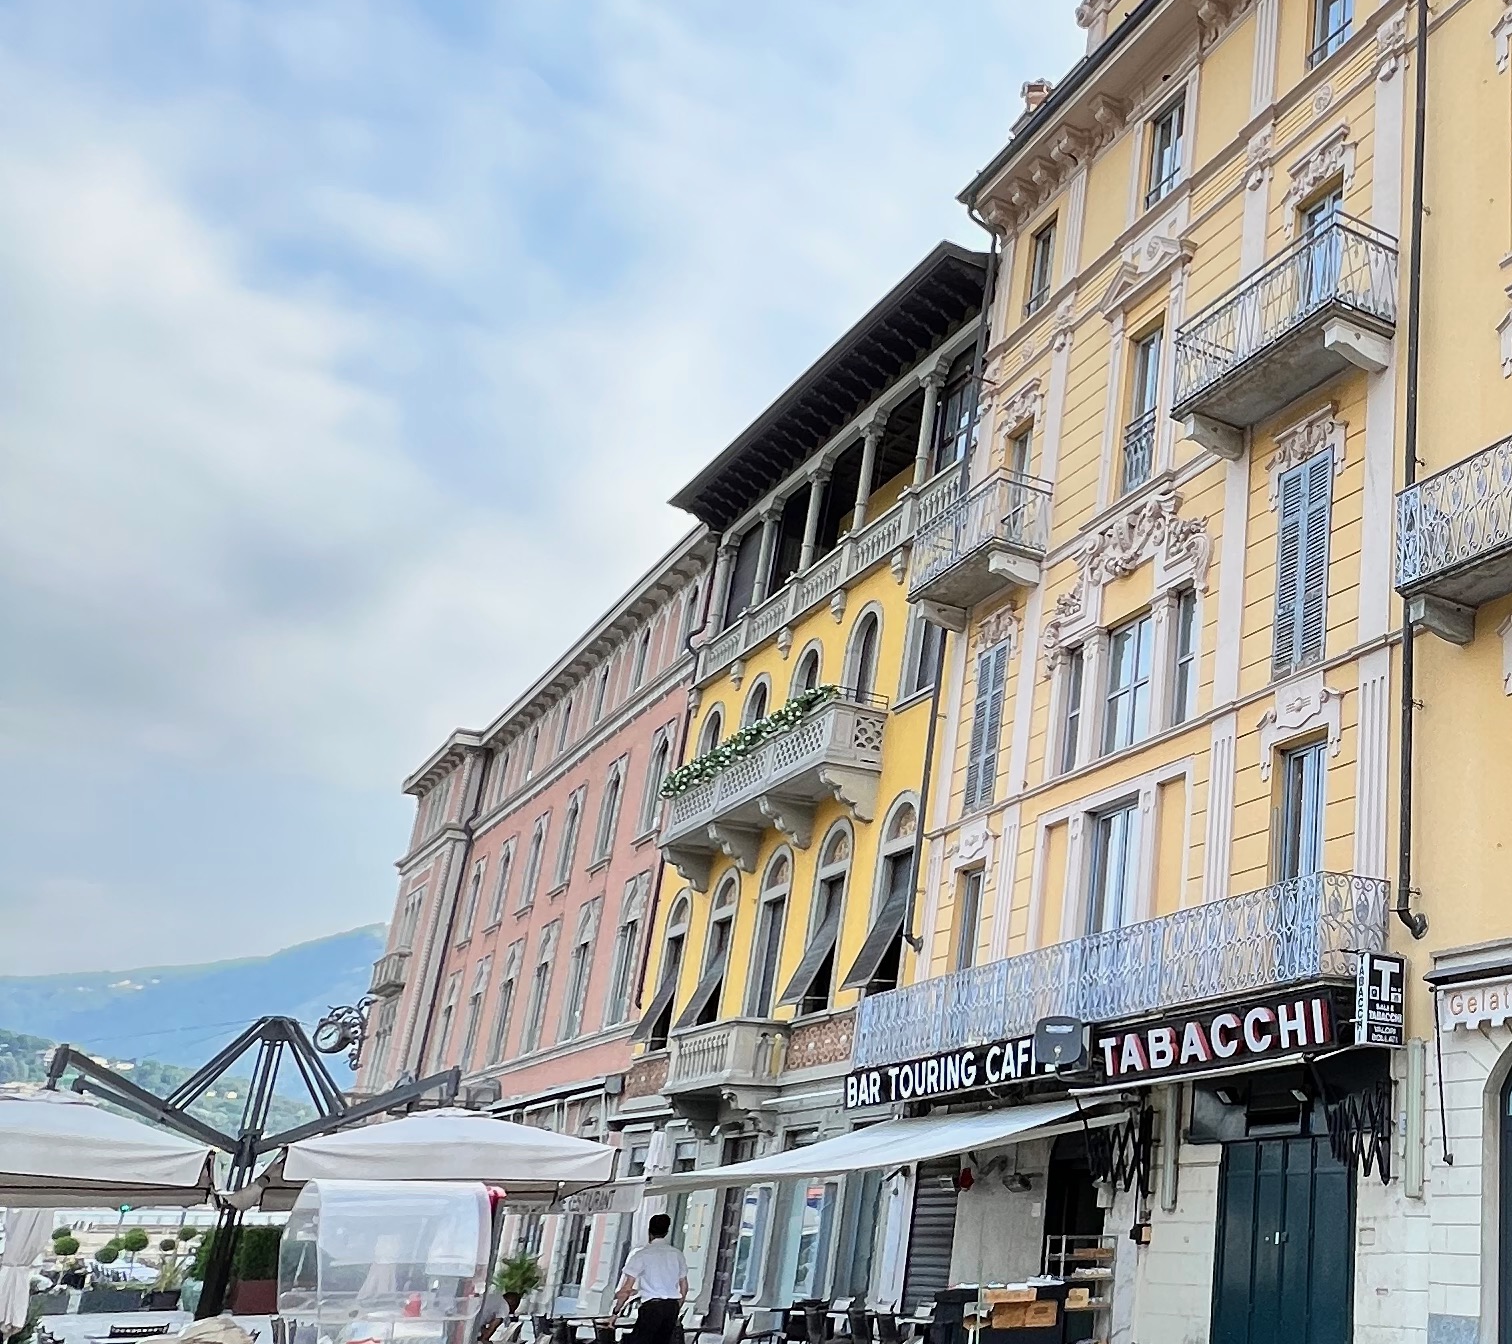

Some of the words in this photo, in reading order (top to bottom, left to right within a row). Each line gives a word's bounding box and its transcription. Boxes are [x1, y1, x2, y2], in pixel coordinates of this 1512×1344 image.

[1373, 959, 1400, 1002] T
[1099, 998, 1332, 1077] TABACCHI
[847, 1070, 881, 1108] BAR
[888, 1050, 977, 1101] TOURING
